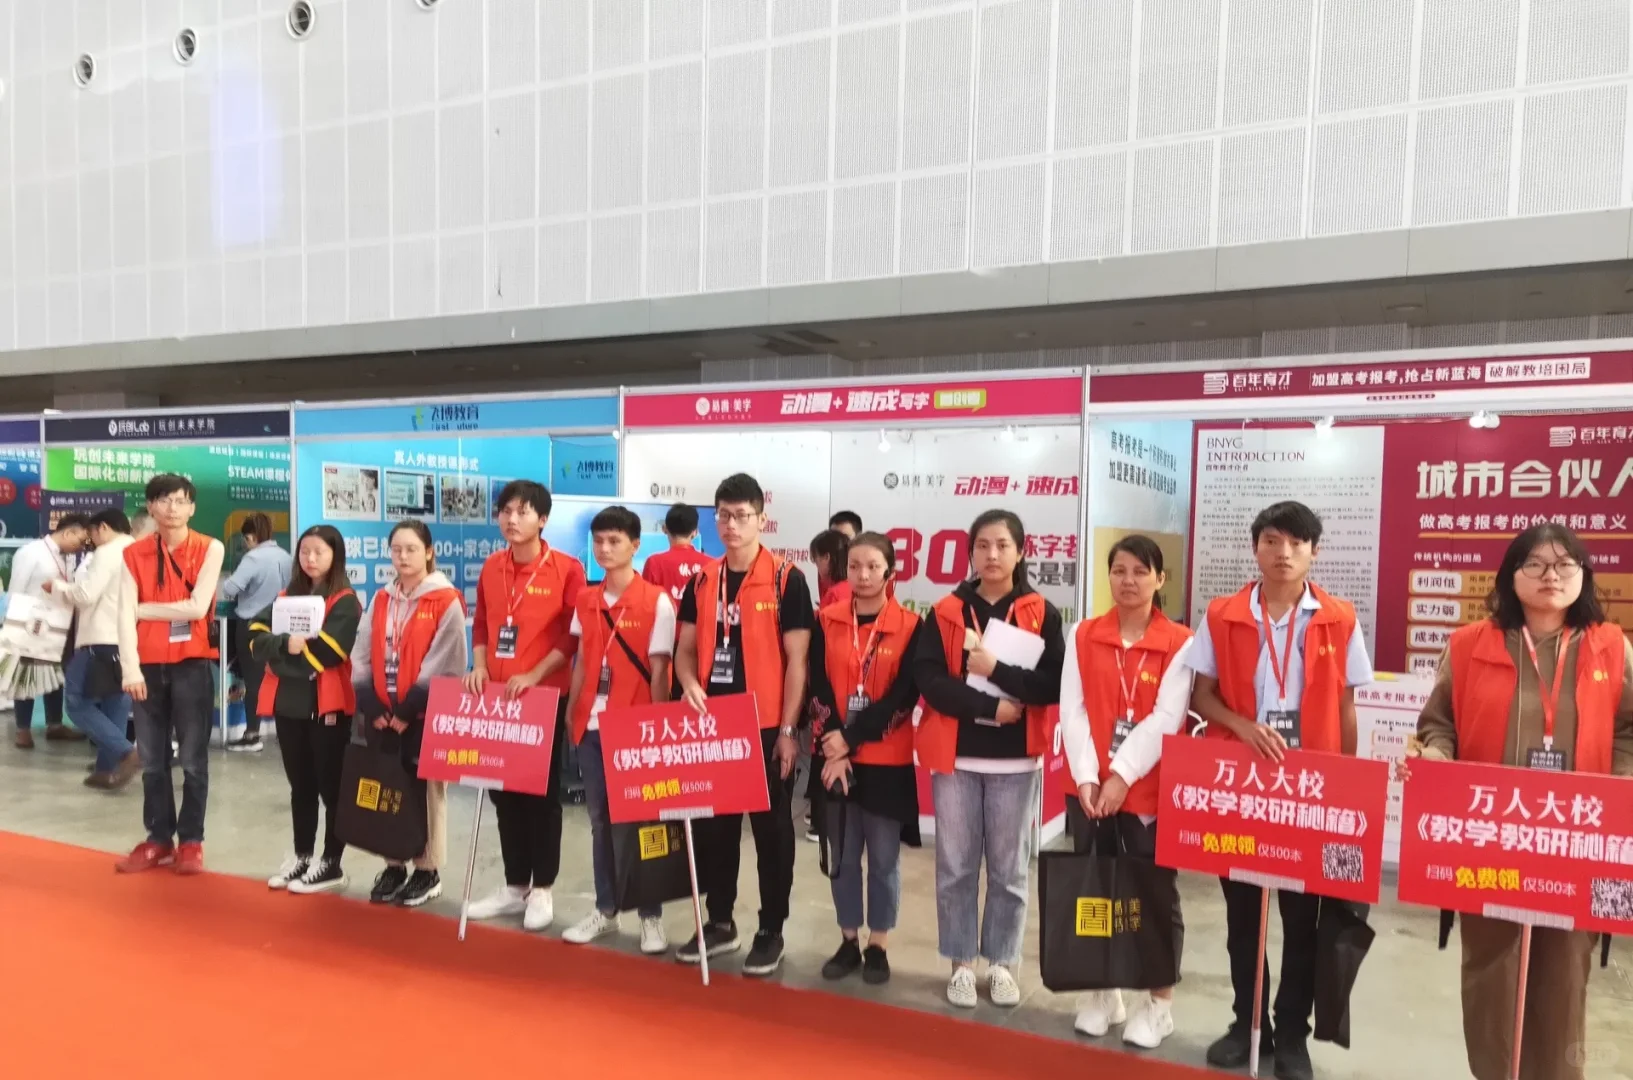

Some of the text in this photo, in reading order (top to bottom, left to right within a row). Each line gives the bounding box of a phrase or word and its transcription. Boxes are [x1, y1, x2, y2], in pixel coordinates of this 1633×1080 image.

[1233, 371, 1293, 387] 百年育才
[158, 418, 216, 432] 玩创未来学院
[74, 447, 156, 468] 玩创未来学院
[1419, 513, 1627, 530] 做高考报考的价值和意义
[1417, 576, 1456, 589] 利润低
[1416, 603, 1455, 616] 实力弱
[458, 693, 522, 720] 万人大校
[638, 713, 718, 743] 万人大校
[641, 778, 681, 801] 免费领
[1213, 758, 1325, 799] 万人大校
[1468, 784, 1603, 828] 万人大校
[1203, 831, 1255, 856] 免费领
[1455, 866, 1520, 891] 免费领
